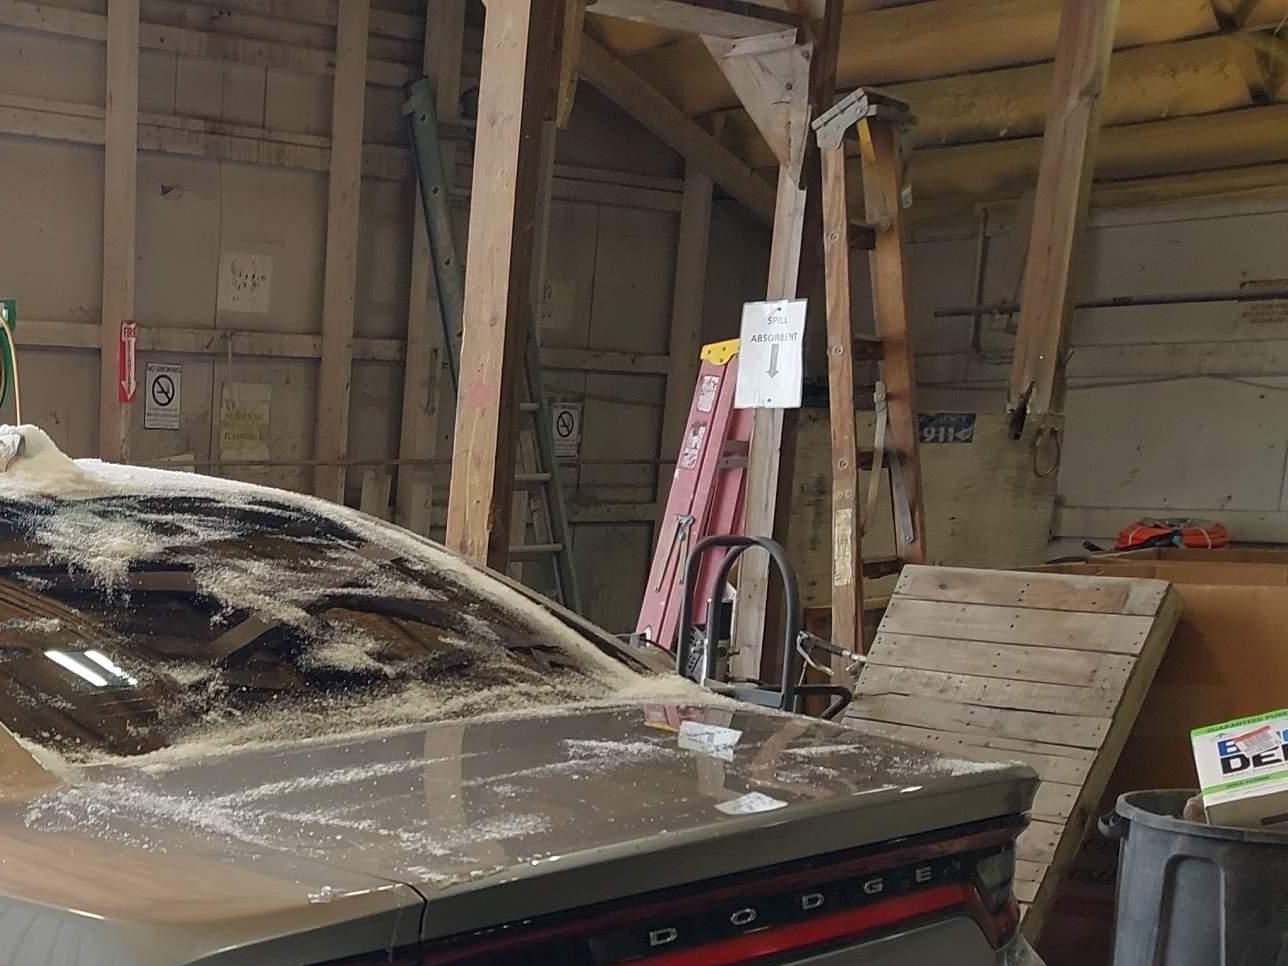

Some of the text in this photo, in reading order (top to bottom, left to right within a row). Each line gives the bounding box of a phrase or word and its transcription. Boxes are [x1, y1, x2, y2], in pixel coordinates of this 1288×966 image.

[767, 315, 788, 325] SPILL
[751, 332, 798, 343] ABSORBENT
[156, 366, 181, 374] SMOKING
[923, 427, 954, 442] 911
[649, 867, 932, 946] DODGE
